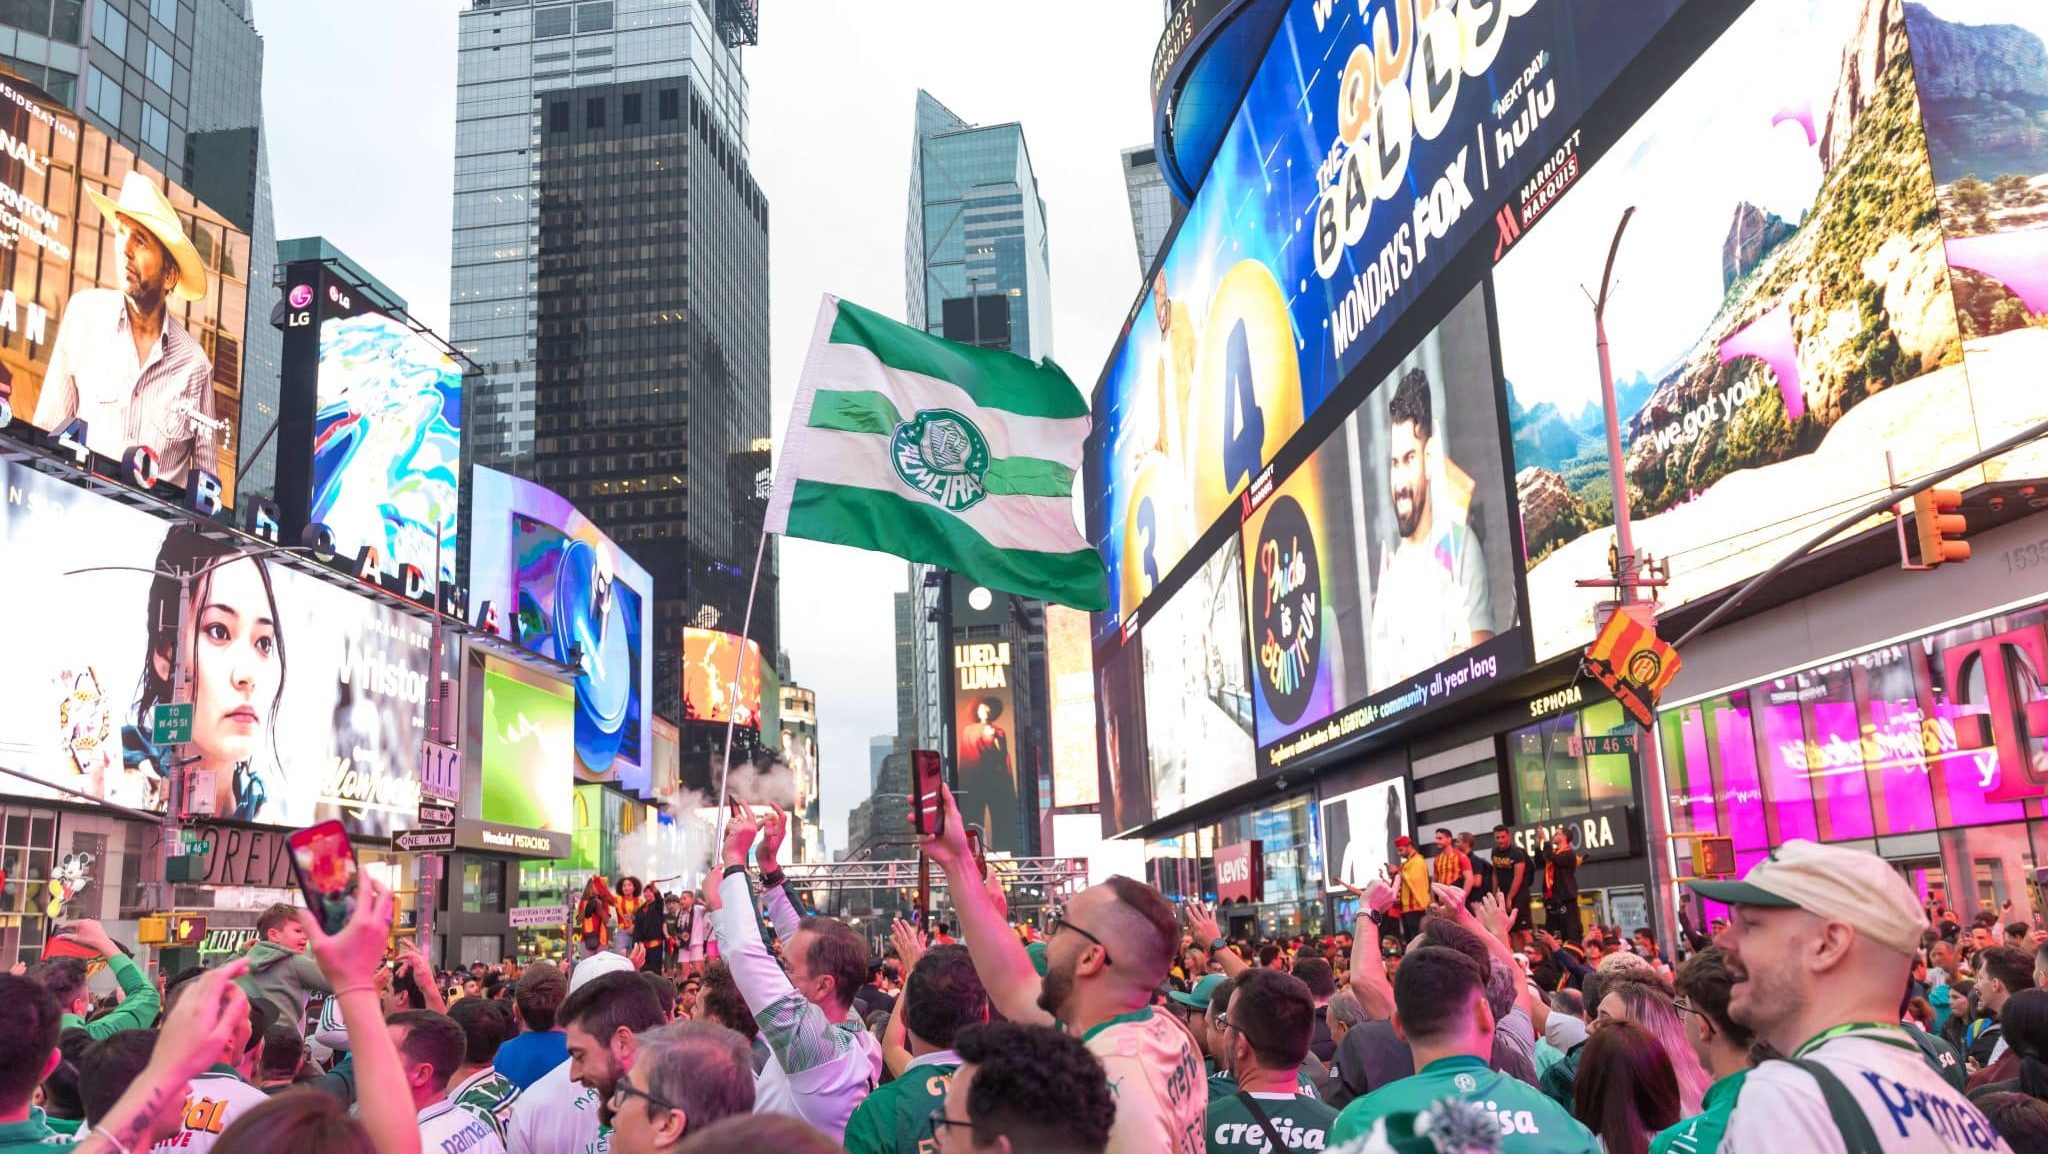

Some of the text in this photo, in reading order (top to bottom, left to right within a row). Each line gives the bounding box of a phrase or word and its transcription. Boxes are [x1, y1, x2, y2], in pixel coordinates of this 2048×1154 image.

[1154, 0, 1197, 76] MARRIOT
[1156, 21, 1191, 95] MARQUIS
[1496, 50, 1545, 120] NEXT DAY
[1495, 78, 1556, 169] hulu
[1316, 137, 1347, 198] THE
[1521, 129, 1581, 204] MARRIOTT
[1523, 159, 1577, 224] MARQUIS
[1413, 145, 1474, 263] FOX
[289, 312, 310, 327] LG
[1331, 223, 1412, 359] MONDAYS
[1223, 317, 1266, 494] 4
[1652, 375, 1760, 453] we got you
[1261, 535, 1306, 617] Pride
[1280, 603, 1292, 638] is
[159, 720, 166, 728] W
[166, 719, 179, 728] 45
[1328, 720, 1341, 741] the
[1379, 684, 1428, 718] community
[1430, 673, 1443, 696] all
[1444, 667, 1468, 696] year
[1470, 655, 1497, 680] long
[1529, 686, 1583, 718] SEPHORA
[1584, 738, 1597, 753] W
[1603, 737, 1620, 752] 46
[401, 834, 447, 845] ONE WAY
[424, 808, 450, 821] ONE WAY
[515, 835, 550, 851] PISTACHIOS
[1215, 1117, 1326, 1154] crefisa
